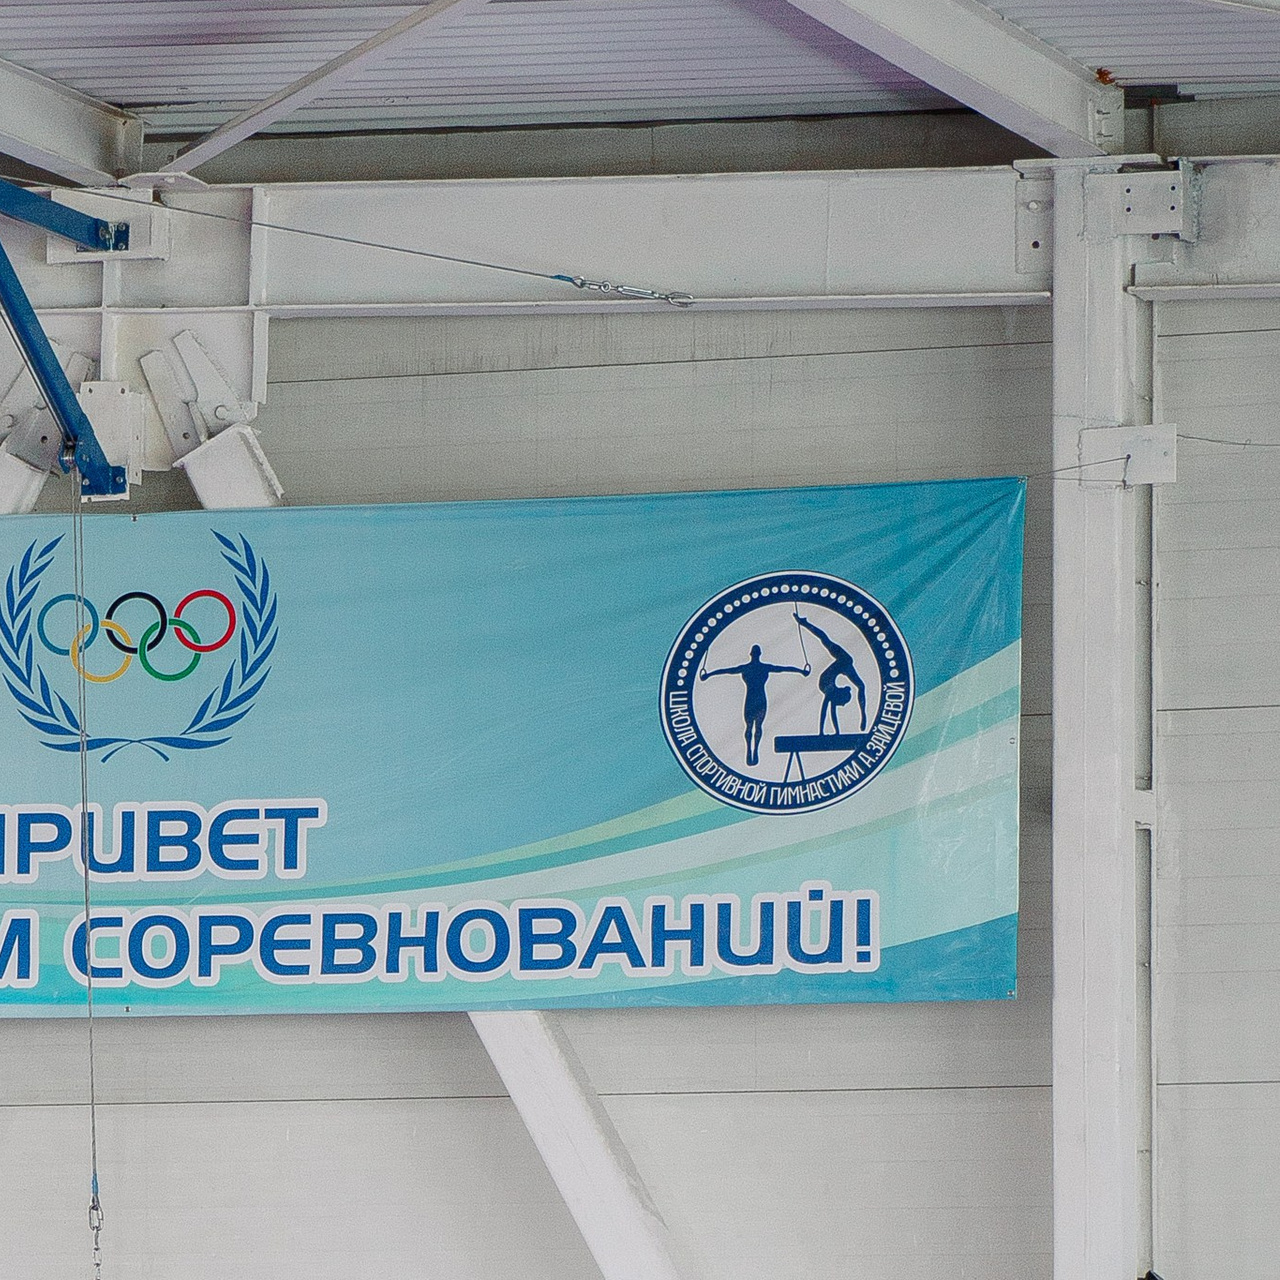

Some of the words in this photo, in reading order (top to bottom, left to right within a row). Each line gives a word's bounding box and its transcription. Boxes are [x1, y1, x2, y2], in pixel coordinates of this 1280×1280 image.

[670, 690, 696, 748] ШКОЛА
[686, 744, 768, 806] СПОРТИВНОЙ
[769, 759, 865, 806] ГИМНАСТИКИ
[70, 888, 872, 979] СОРЕВНОВАНИЙ!
